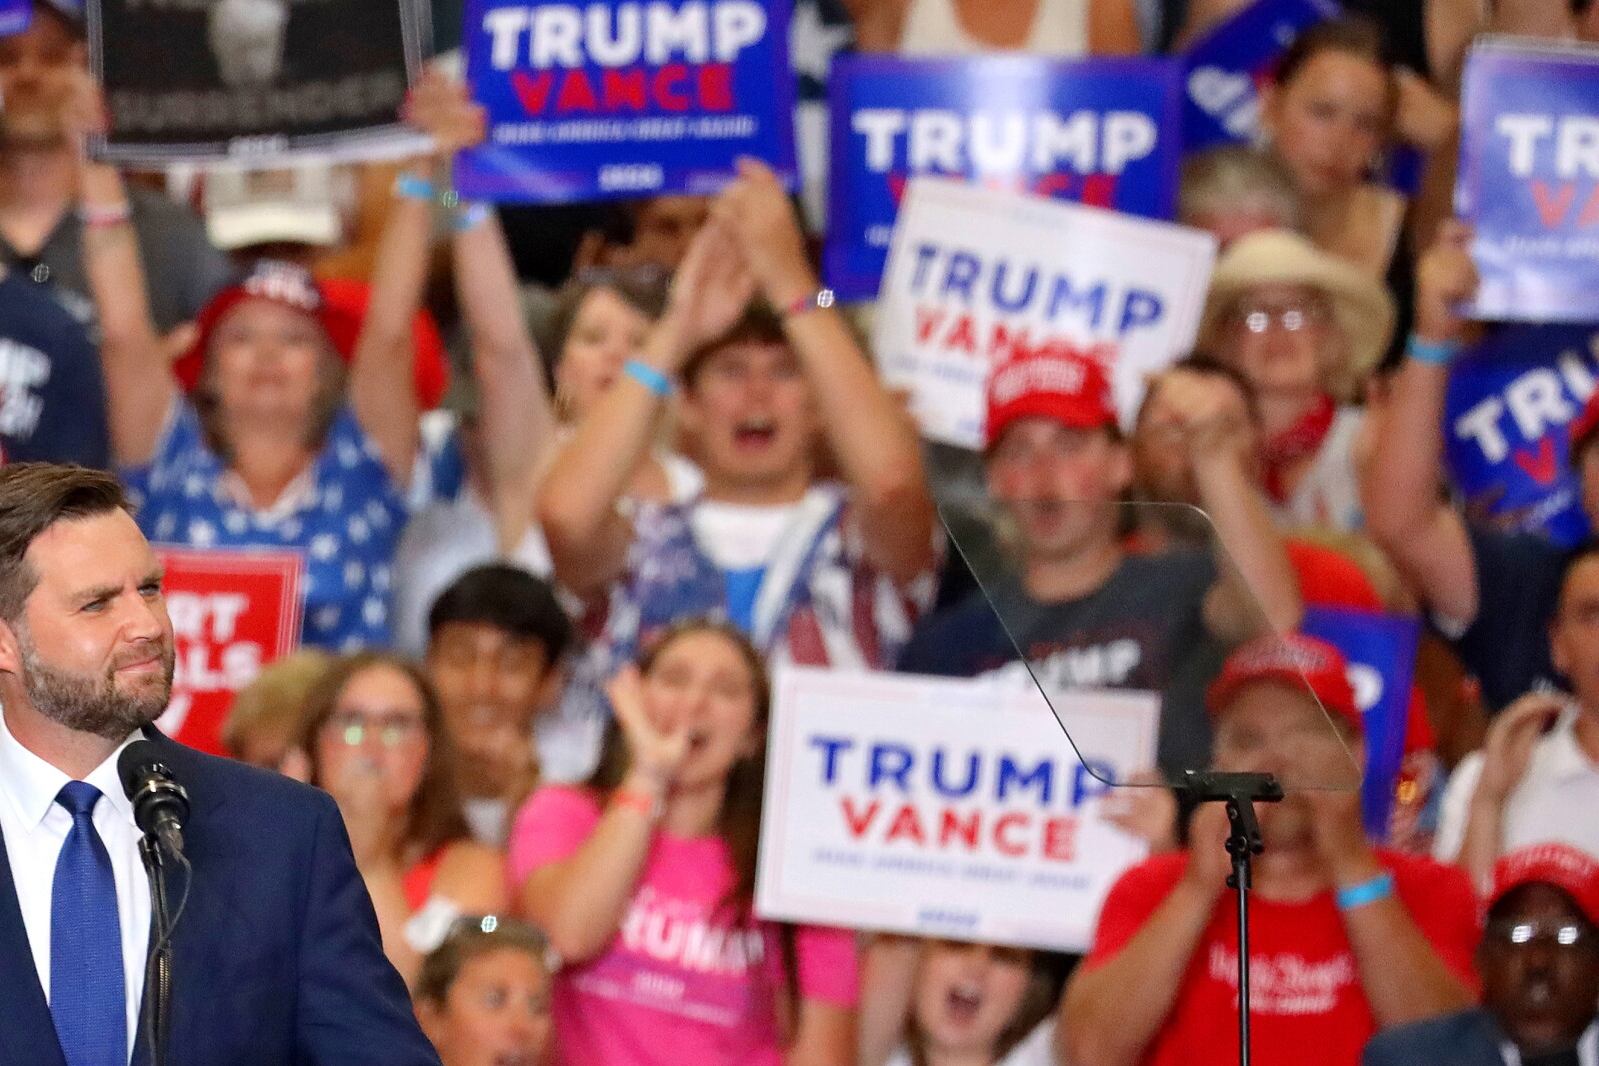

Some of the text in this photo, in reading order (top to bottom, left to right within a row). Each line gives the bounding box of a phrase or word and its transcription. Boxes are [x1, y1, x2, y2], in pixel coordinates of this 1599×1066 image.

[483, 3, 767, 69] TRUMP
[509, 64, 733, 114] VANCE
[851, 109, 1158, 173] TRUMP
[911, 245, 1165, 336] TRUMP
[809, 734, 1117, 808] TRUMP
[840, 797, 1079, 863] VANCE
